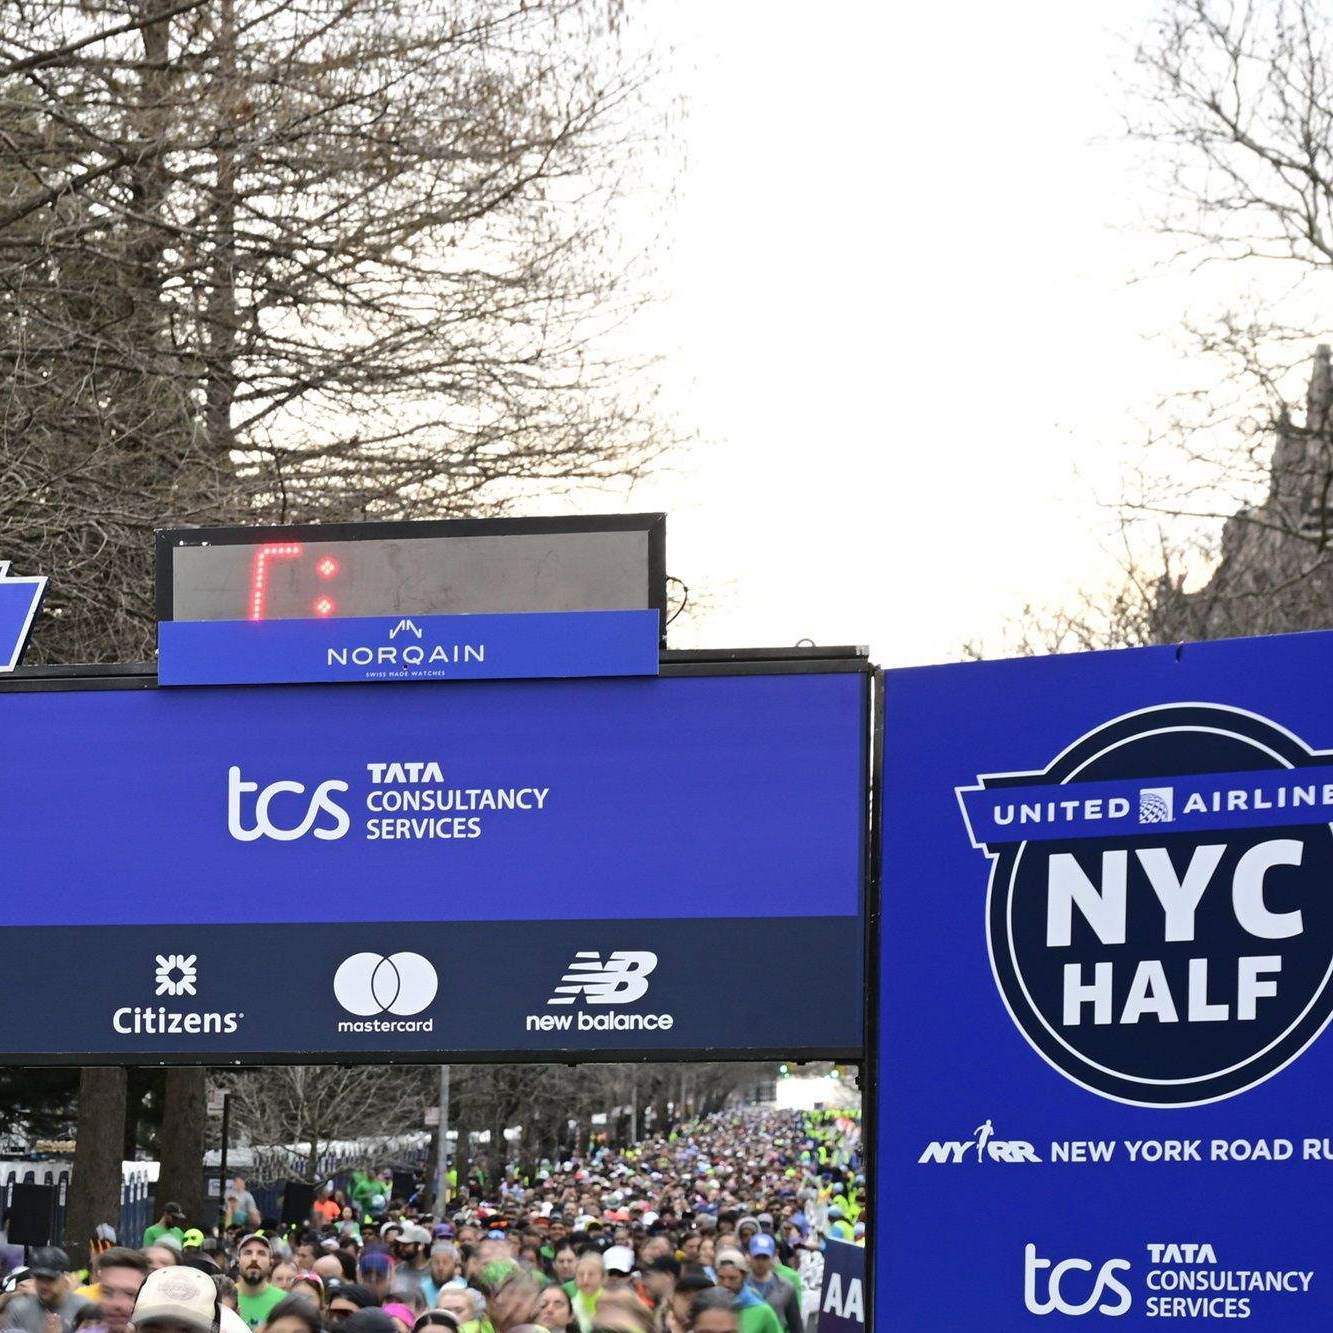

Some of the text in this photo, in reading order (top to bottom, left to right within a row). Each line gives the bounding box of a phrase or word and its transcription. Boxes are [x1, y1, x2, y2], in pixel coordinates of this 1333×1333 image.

[328, 645, 484, 665] NORQAIN
[367, 763, 444, 783] TATA
[228, 766, 350, 841] tcs
[367, 789, 549, 811] CONSULTANCY
[994, 798, 1129, 825] UNITED
[367, 818, 481, 839] SERVICES
[1047, 839, 1303, 947] NYC
[1063, 955, 1282, 1026] HALF
[113, 1007, 237, 1034] Citizens
[339, 1019, 432, 1032] mastercard
[527, 1011, 673, 1030] new balance
[1052, 1141, 1115, 1162] NEW
[1124, 1140, 1201, 1161] YORK
[1211, 1139, 1293, 1160] ROAD
[1147, 1244, 1217, 1263] TATA
[1025, 1243, 1131, 1316] tcs
[1147, 1270, 1313, 1291] CONSULTANCY
[1147, 1297, 1250, 1318] SERVICES
